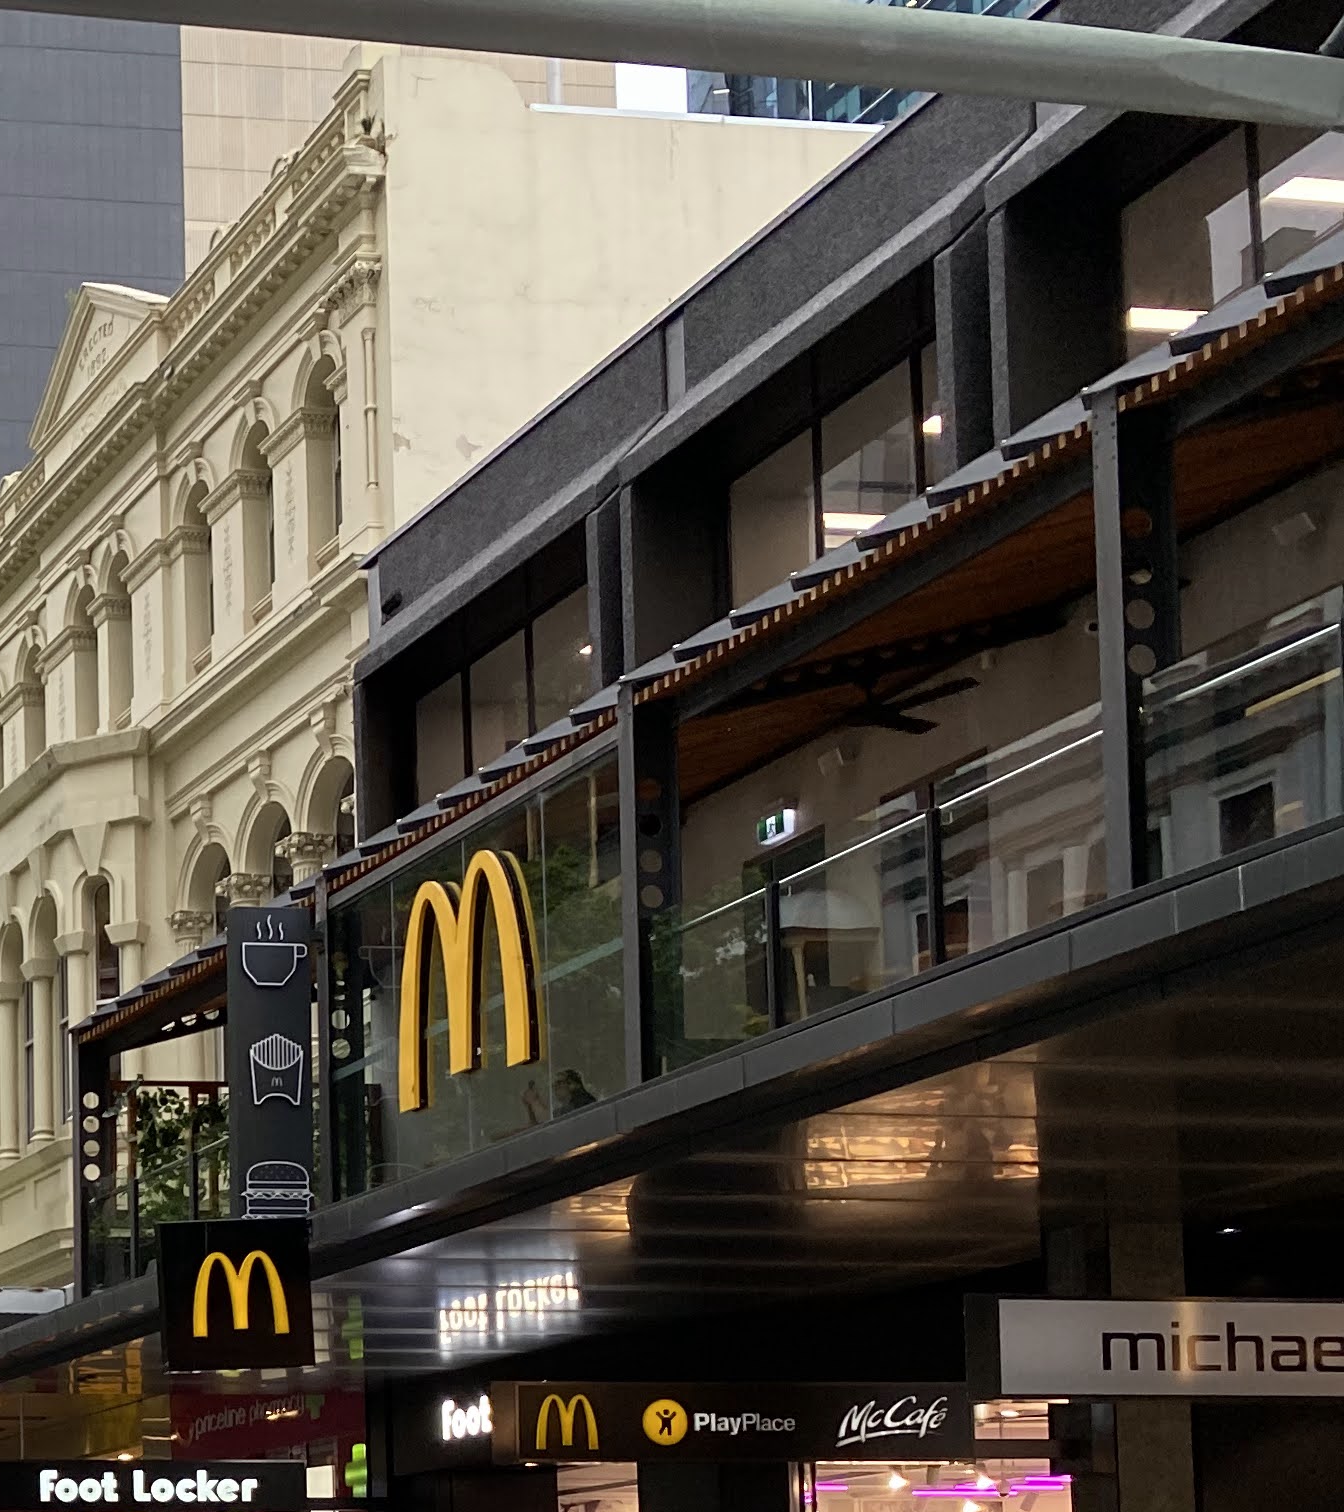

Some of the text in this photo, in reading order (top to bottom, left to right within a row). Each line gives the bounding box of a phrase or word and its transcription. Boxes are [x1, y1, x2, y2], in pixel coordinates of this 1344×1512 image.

[1102, 1321, 1344, 1372] michae
[693, 1412, 796, 1436] PlayPlace
[835, 1395, 948, 1446] McCafé
[39, 1469, 258, 1502] Foot Locker
